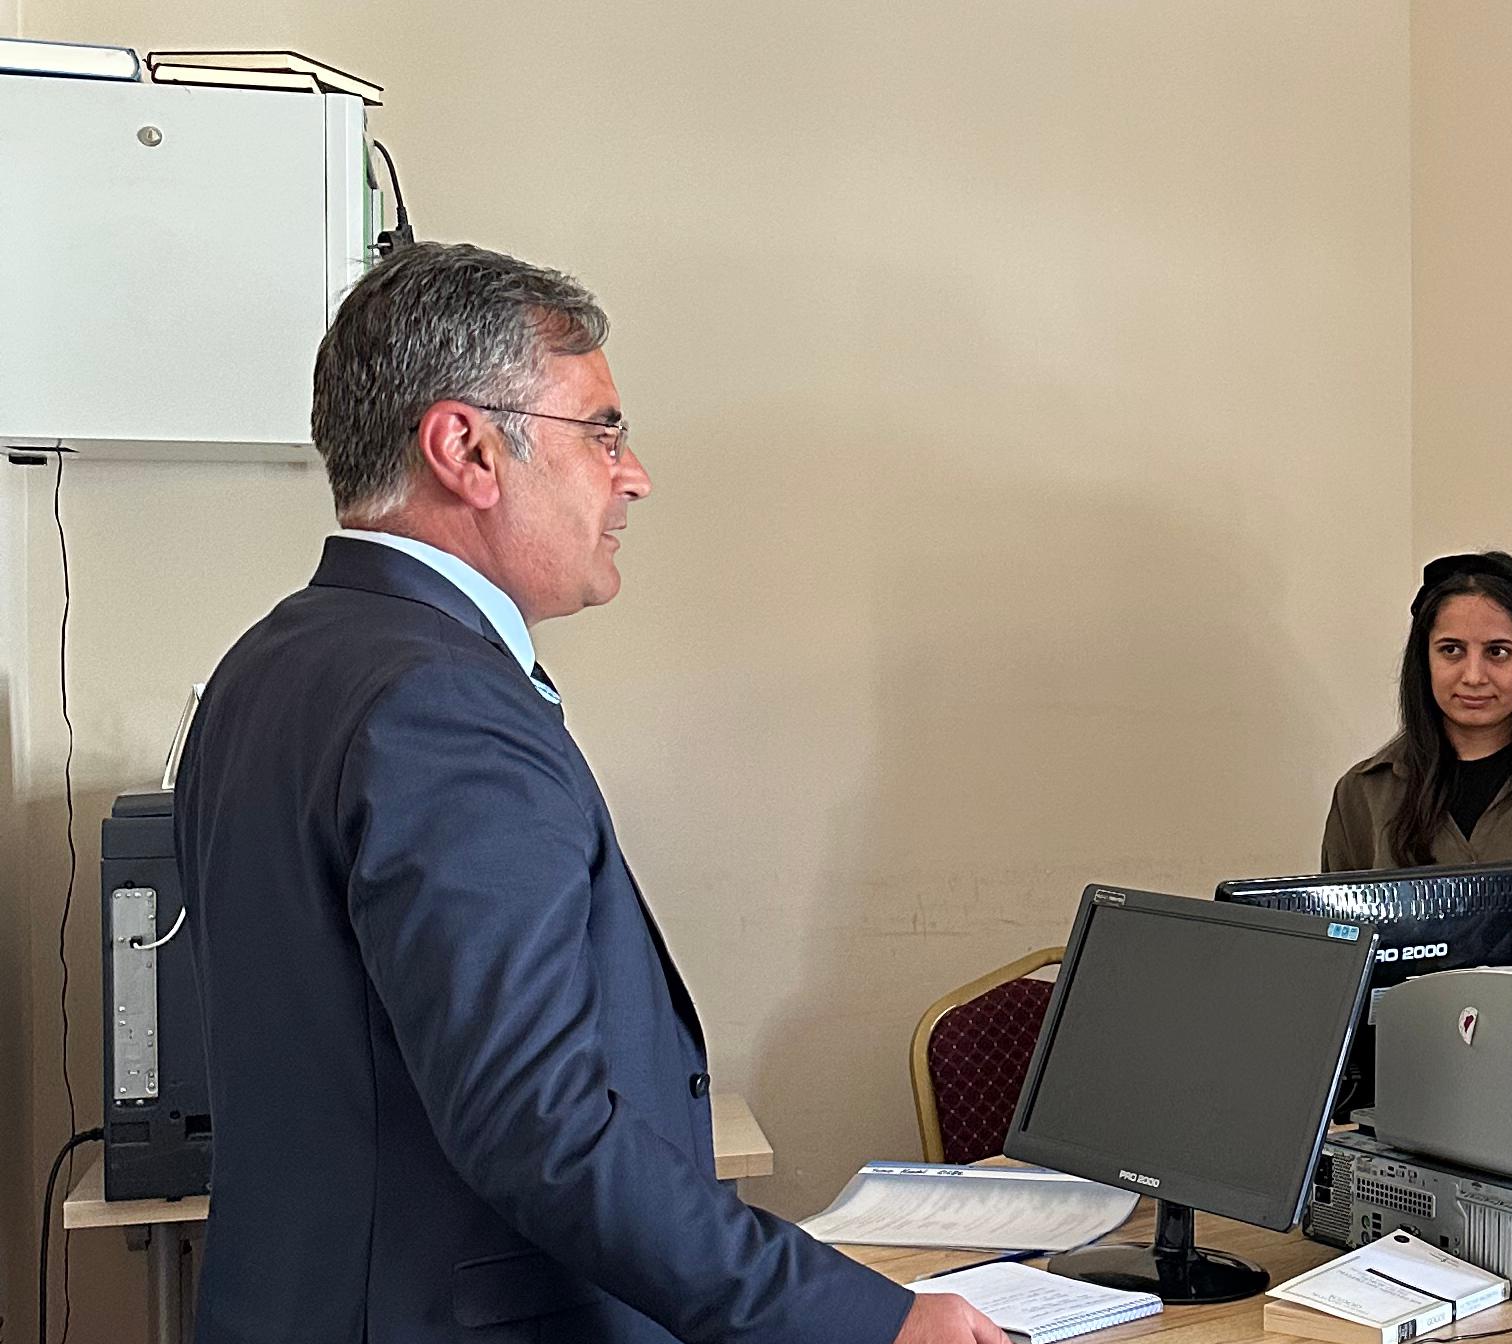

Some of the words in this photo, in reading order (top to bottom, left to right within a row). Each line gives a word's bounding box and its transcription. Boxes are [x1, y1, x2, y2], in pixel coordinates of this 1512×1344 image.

[1376, 948, 1399, 963] RO
[1401, 942, 1448, 961] 2000
[1119, 1169, 1137, 1182] PRO
[1136, 1174, 1160, 1188] 2000
